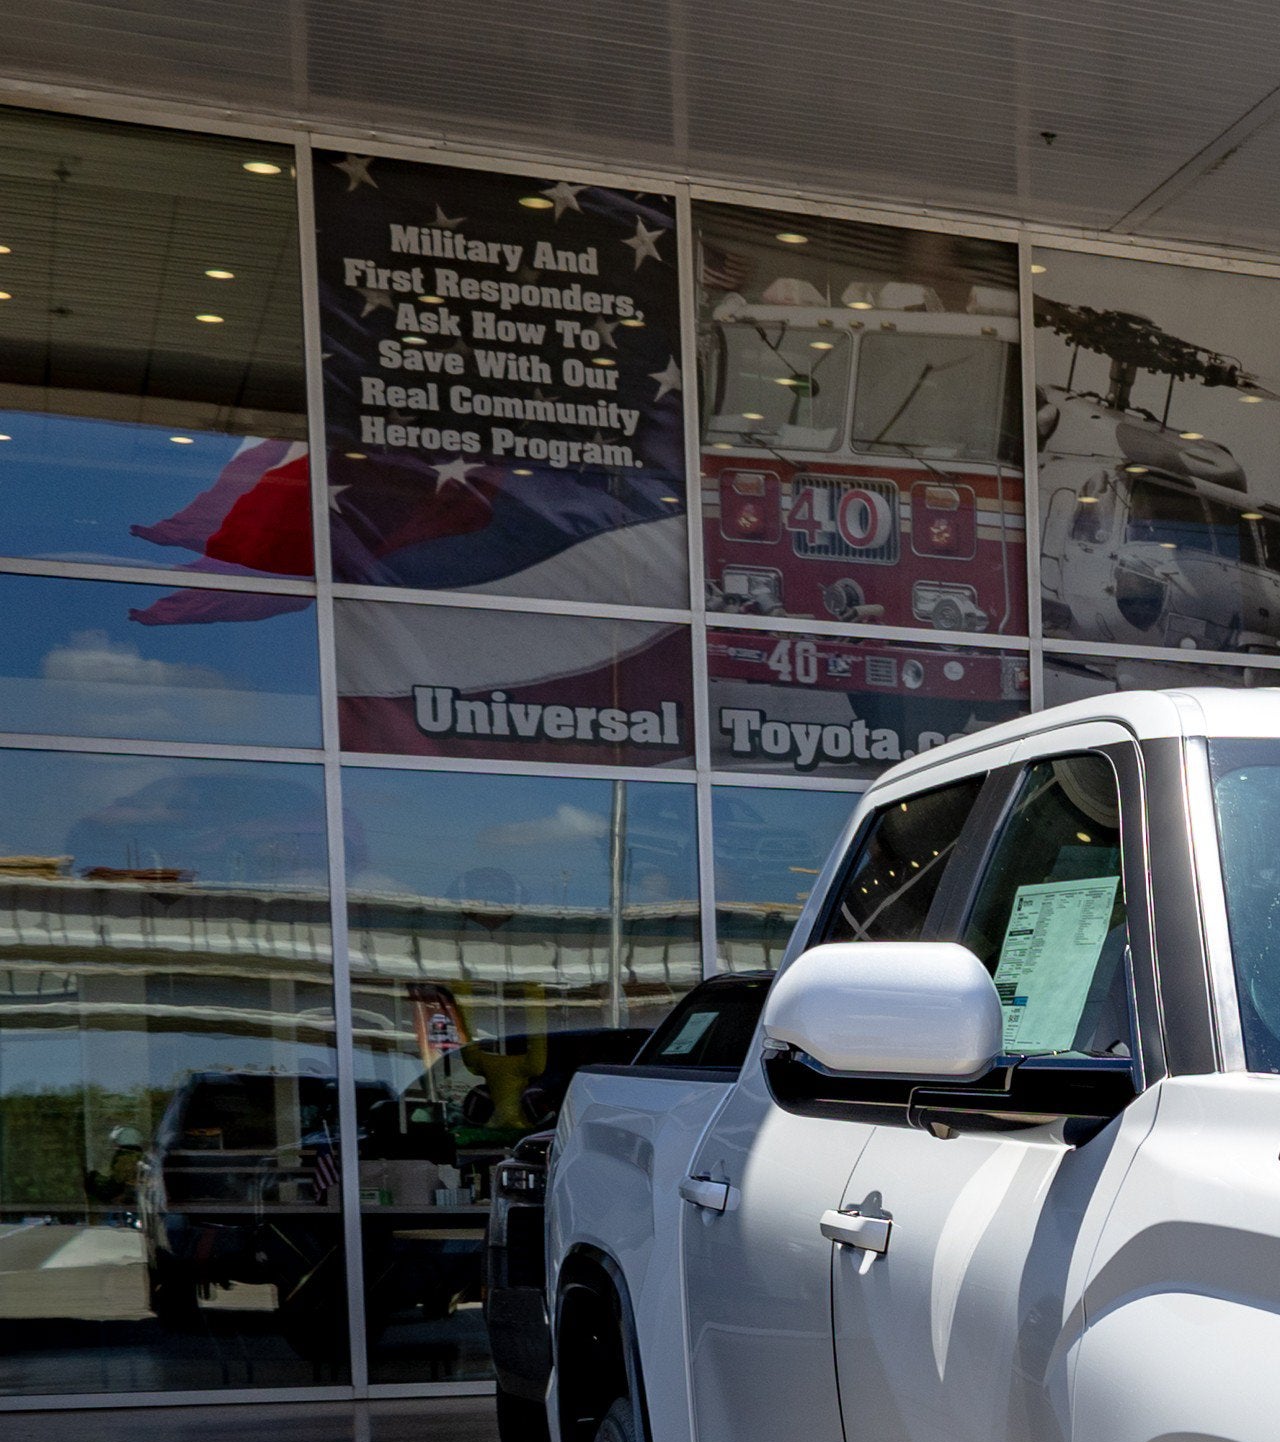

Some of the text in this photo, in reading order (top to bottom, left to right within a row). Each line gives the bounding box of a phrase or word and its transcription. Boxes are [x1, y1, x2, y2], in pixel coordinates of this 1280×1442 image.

[390, 224, 598, 275] Military And
[343, 257, 644, 320] First Responders,
[396, 303, 600, 351] Ask How To
[378, 339, 619, 391] Save With Our
[361, 376, 640, 436] Real Community
[360, 415, 644, 468] Heroes Program.
[786, 486, 892, 549] 40
[767, 639, 818, 684] 40
[413, 686, 968, 766] Universal Toyota.c
